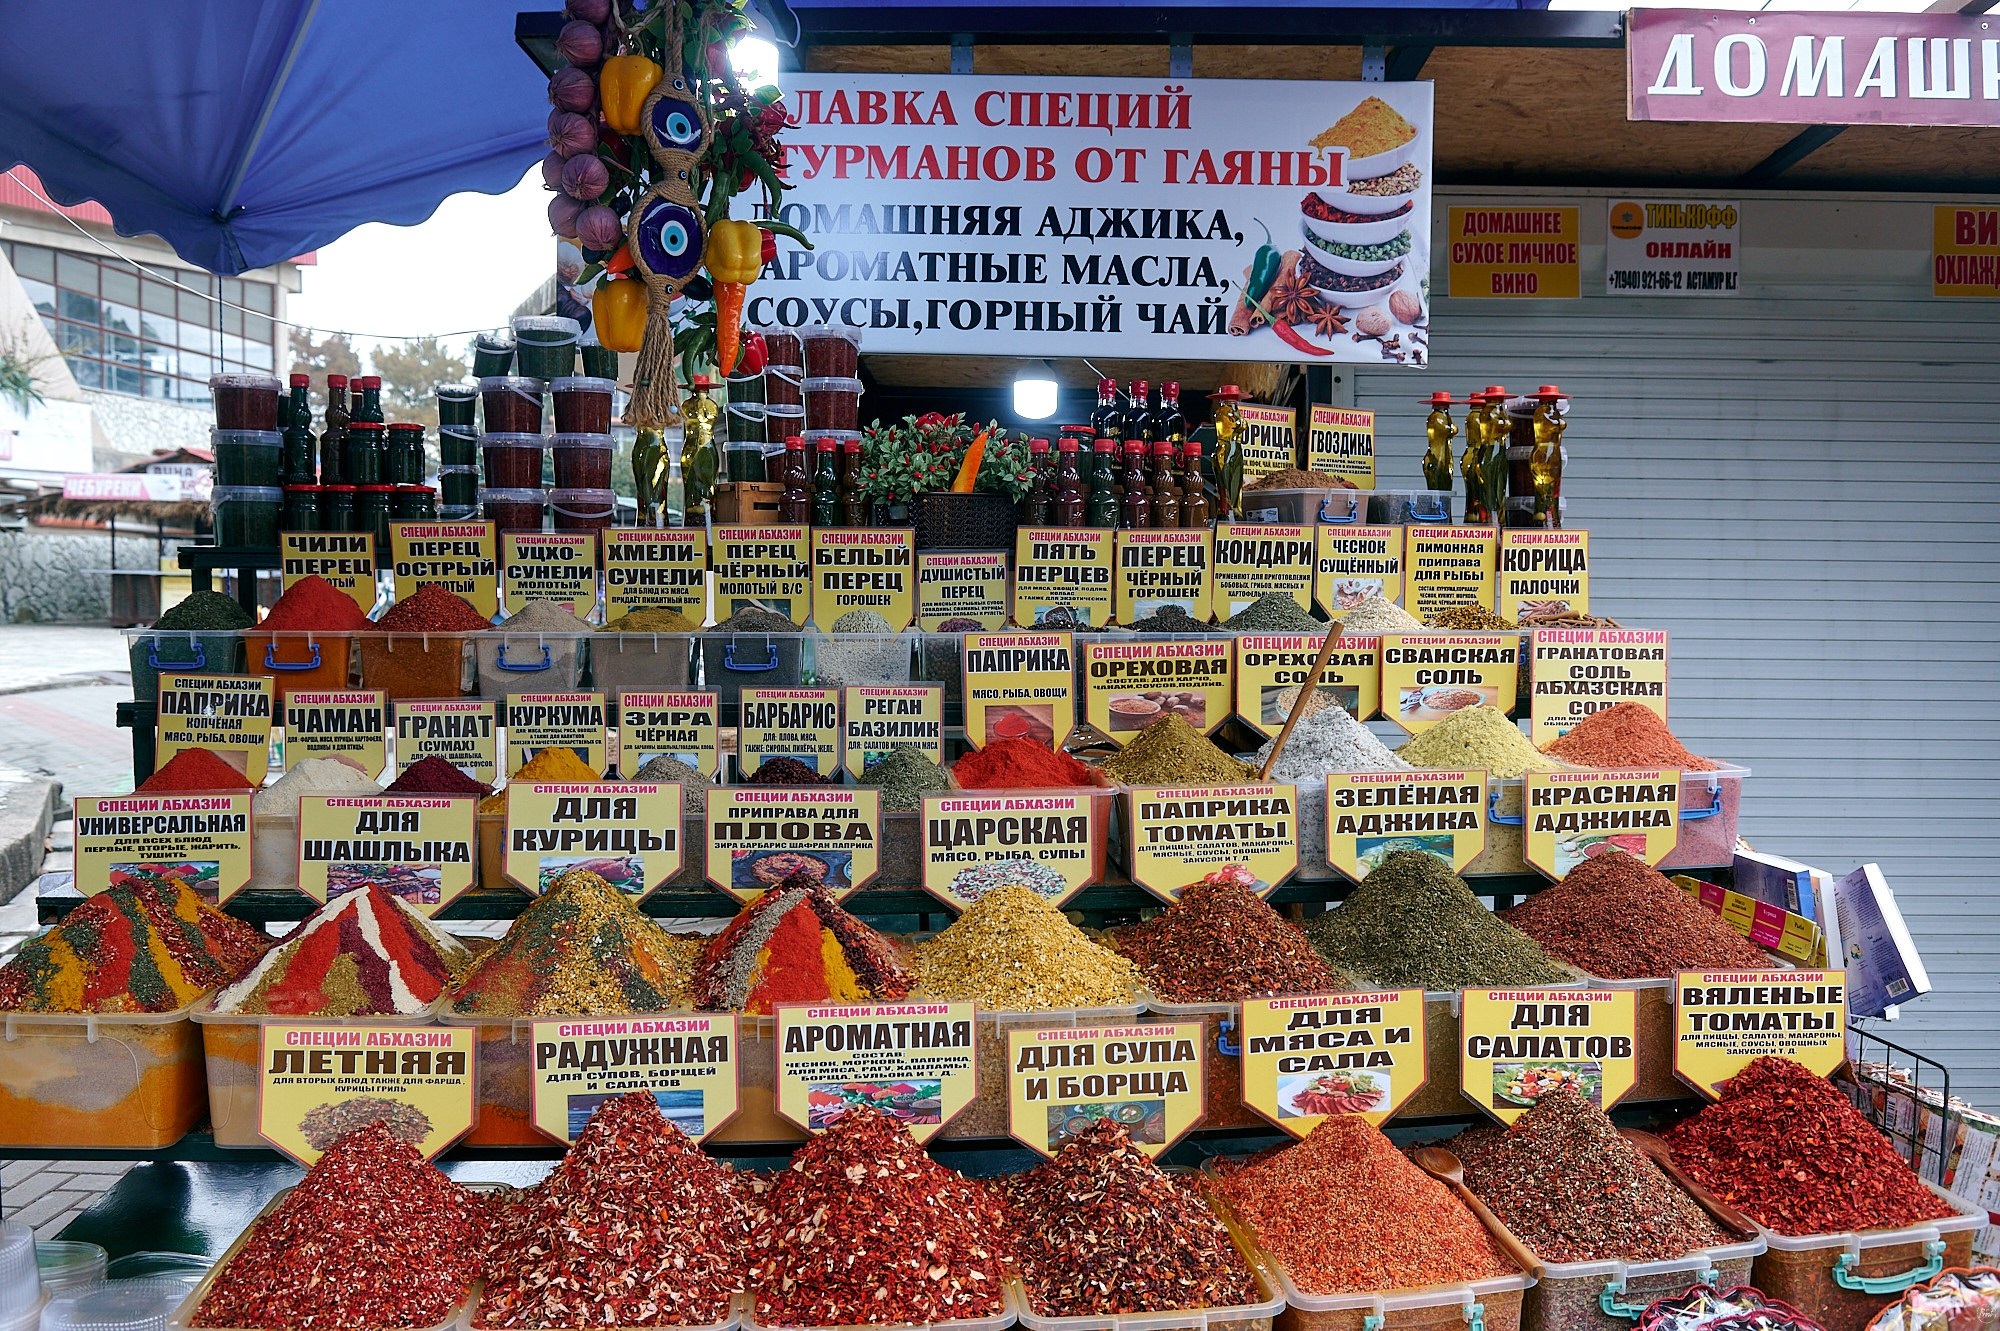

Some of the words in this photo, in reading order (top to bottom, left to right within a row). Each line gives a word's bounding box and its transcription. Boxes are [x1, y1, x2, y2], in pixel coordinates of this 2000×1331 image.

[787, 89, 958, 126] ЛАВКА
[974, 85, 1192, 137] СПЕЦИЙ
[777, 144, 1056, 182] ГУРМАНОВ
[1075, 147, 1146, 183] ОТ
[1163, 149, 1345, 188] ГАЯНЫ
[1463, 212, 1561, 237] ДОМАШНЕЕ
[1645, 203, 1738, 229] ТИНЬКОФФ
[1035, 206, 1244, 247] АДЖИКА,
[1452, 242, 1504, 264] СУХОЕ
[1508, 242, 1576, 264] ЛИЧНОЕ
[1646, 239, 1731, 259] ОНЛАЙН
[758, 250, 1048, 284] АРОМАТНЫЕ
[1061, 254, 1230, 294] МАСЛА,
[1609, 270, 1640, 290] +7(940)
[1641, 270, 1682, 290] 921-66-12
[1686, 271, 1724, 290] АСТАМУР
[1491, 272, 1538, 294] ВИНО
[1136, 296, 1229, 335] ЧАЙ
[1314, 410, 1340, 425] СПЕЦИИ
[1341, 412, 1371, 427] АБХАЗИИ
[1241, 424, 1294, 451] ОРИЦА
[1310, 430, 1373, 458] ГВОЗДИКА
[1243, 449, 1289, 460] ОЛОТАЯ
[400, 527, 439, 538] СПЕЦИИ
[441, 527, 485, 536] АБХАЗИИ
[288, 536, 366, 553] ЧИЛИ
[409, 542, 480, 558] ПЕРЕЦ
[608, 544, 703, 561] ХМЕЛИ-
[726, 545, 796, 560] ПЕРЕЦ
[1032, 544, 1096, 560] ПЯТЬ
[1332, 539, 1386, 554] ЧЕСНОК
[1416, 543, 1484, 554] ЛИМОННАЯ
[517, 546, 583, 562] УЦХО-
[816, 546, 910, 566] БЕЛЫЙ
[1122, 546, 1206, 569] ПЕРЕЦ
[1216, 540, 1312, 569] КОНДАРИ
[1503, 548, 1586, 576] КОРИЦА
[285, 559, 372, 576] ПЕРЕЦ
[396, 558, 495, 576] ОСТРЫЙ
[508, 565, 592, 579] СУНЕЛИ
[714, 562, 808, 578] ЧЁРНЫЙ
[1320, 557, 1398, 575] СУЩЁННЫЙ
[1418, 559, 1481, 568] приправа
[608, 568, 703, 586] СУНЕЛИ
[823, 572, 903, 593] ПЕРЕЦ
[920, 565, 1005, 583] ДУШИСТЫЙ
[1018, 566, 1109, 585] ПЕРЦЕВ
[1127, 569, 1202, 585] ЧЁРНЫЙ
[1414, 571, 1441, 582] ДЛЯ
[1444, 571, 1484, 581] РЫБЫ
[518, 580, 581, 589] МОЛОТЫЙ
[639, 588, 659, 596] БЛЮД
[720, 580, 777, 594] МОЛОТЫЙ
[782, 582, 803, 595] В/С
[941, 586, 985, 599] ПЕРЕЦ
[1129, 588, 1199, 597] ГОРОШЕК
[1510, 579, 1580, 595] ПАЛОЧКИ
[836, 594, 891, 606] ГОРОШЕК
[1538, 630, 1594, 645] СПЕЦИИ
[1598, 632, 1664, 644] АБХАЗИИ
[967, 649, 1070, 673] ПАПРИКА
[1385, 648, 1515, 664] СВАНСКАЯ
[1536, 647, 1664, 660] ГРАНАТОВАЯ
[1090, 659, 1227, 678] ОРЕХОВАЯ
[1416, 669, 1483, 685] СОЛЬ
[1569, 665, 1631, 679] СОЛЬ
[175, 679, 214, 690] СПЕЦИИ
[216, 680, 261, 690] АБХАЗИИ
[1535, 682, 1663, 696] АБХАЗСКАЯ
[161, 691, 270, 717] ПАПРИКА
[865, 699, 922, 715] РЕГАН
[186, 716, 242, 730] КОПЧЁНАЯ
[288, 708, 381, 733] ЧАМАН
[509, 705, 603, 727] КУРКУМА
[625, 712, 712, 726] ЗИРА
[743, 703, 836, 729] БАРБАРИС
[399, 716, 493, 739] ГРАНАТ
[635, 728, 698, 742] ЧЁРНАЯ
[848, 721, 939, 738] БАЗИЛИК
[164, 732, 194, 742] МЯСО,
[197, 733, 227, 743] РЫБА,
[229, 734, 264, 745] ОВОЩИ
[418, 740, 475, 752] (СУМАХ)
[1550, 774, 1599, 783] СПЕЦИИ
[1602, 772, 1660, 781] АБХАЗИИ
[534, 786, 589, 794] СПЕЦИИ
[1335, 784, 1479, 807] ЗЕЛЁНАЯ
[1532, 785, 1676, 806] КРАСНАЯ
[552, 798, 637, 823] ДЛЯ
[728, 808, 818, 819] ПРИПРАВА
[822, 809, 859, 820] ДЛЯ
[1141, 799, 1291, 820] ПАПРИКА
[79, 814, 246, 836] УНИВЕРСАЛЬНАЯ
[355, 811, 419, 834] ДЛЯ
[1336, 811, 1478, 835] АДЖИКА
[1535, 810, 1671, 833] АДЖИКА
[714, 822, 873, 840] ПЛОВА
[929, 816, 1087, 850] ЦАРСКАЯ
[1144, 822, 1286, 842] ТОМАТЫ
[303, 840, 470, 862] ШАШЛЫКА
[513, 830, 676, 854] КУРИЦЫ
[931, 852, 981, 862] МЯСО,
[984, 851, 1034, 861] РЫБА,
[1039, 850, 1085, 859] СУПЫ
[1702, 974, 1757, 983] СПЕЦИИ
[1761, 974, 1823, 982] АБХАЗИИ
[1683, 987, 1842, 1005] ВЯЛЕНЫЕ
[1287, 1008, 1381, 1030] ДЛЯ
[1511, 1004, 1589, 1029] ДЛЯ
[1688, 1012, 1835, 1031] ТОМАТЫ
[286, 1031, 360, 1047] СПЕЦИИ
[366, 1032, 452, 1047] АБХАЗИИ
[785, 1021, 971, 1053] АРОМАТНАЯ
[1250, 1030, 1373, 1054] МЯСА
[1385, 1027, 1410, 1043] И
[536, 1035, 728, 1072] РАДУЖНАЯ
[1016, 1044, 1094, 1072] ДЛЯ
[1105, 1040, 1196, 1065] СУПА
[1468, 1036, 1631, 1058] САЛАТОВ
[268, 1050, 465, 1075] ЛЕТНЯЯ
[1278, 1051, 1394, 1073] САЛА
[546, 1074, 582, 1083] ДЛЯ
[587, 1070, 644, 1080] СУПОВ,
[648, 1066, 716, 1077] БОРЩЕЙ
[606, 1079, 680, 1089] САЛАТОВ
[1026, 1078, 1048, 1100] И
[1058, 1071, 1188, 1099] БОРЩА
